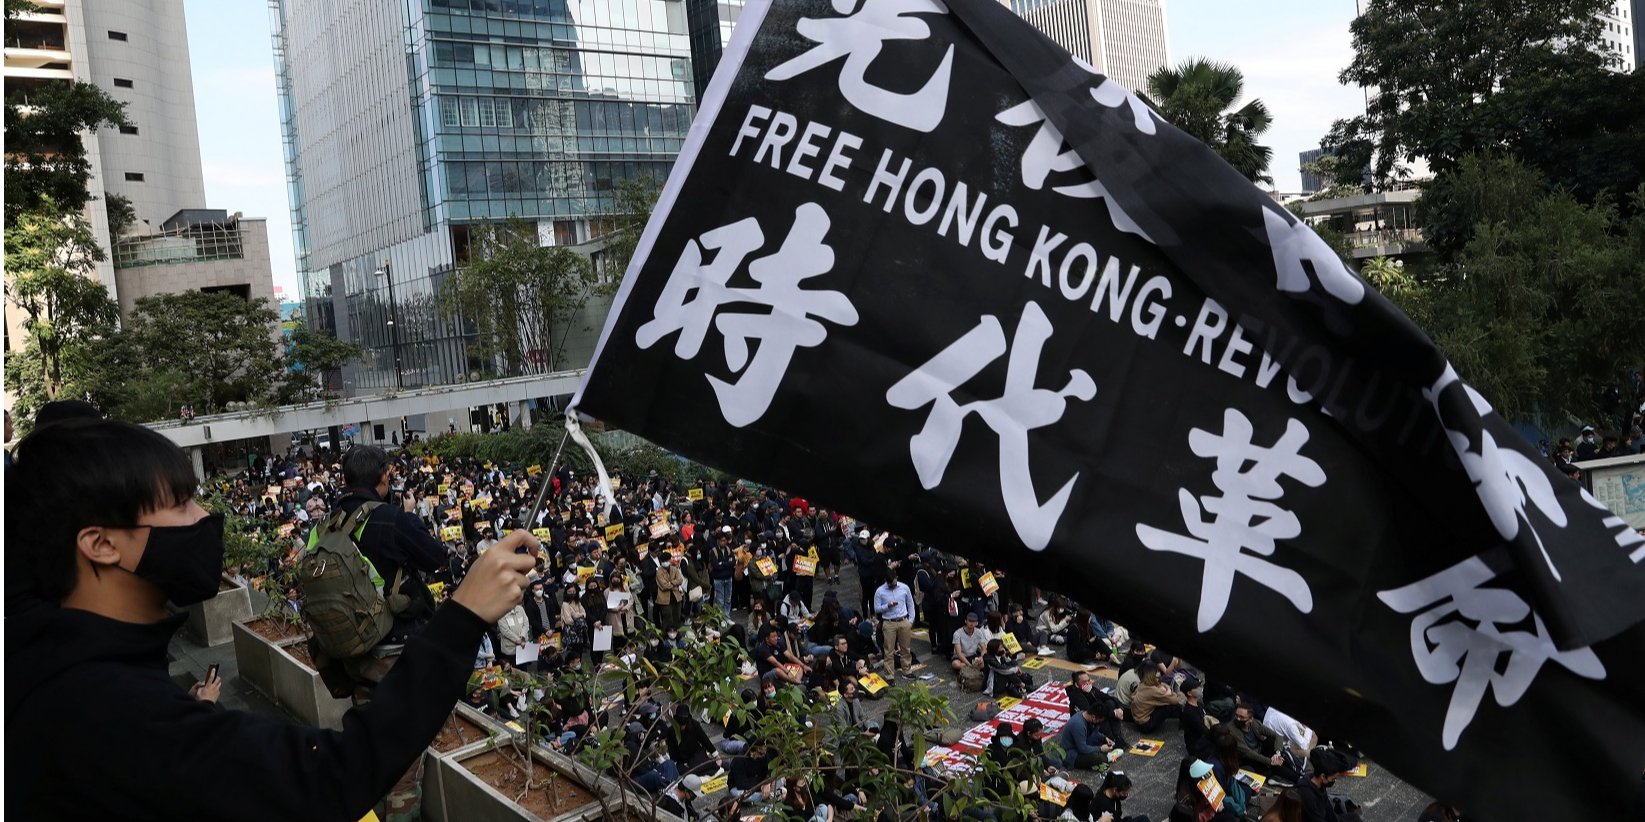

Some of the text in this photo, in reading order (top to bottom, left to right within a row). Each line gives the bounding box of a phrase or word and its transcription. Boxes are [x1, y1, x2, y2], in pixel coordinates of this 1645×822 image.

[729, 105, 863, 191] FREE
[863, 148, 1018, 264] HONG
[636, 202, 1606, 750] 時代革命
